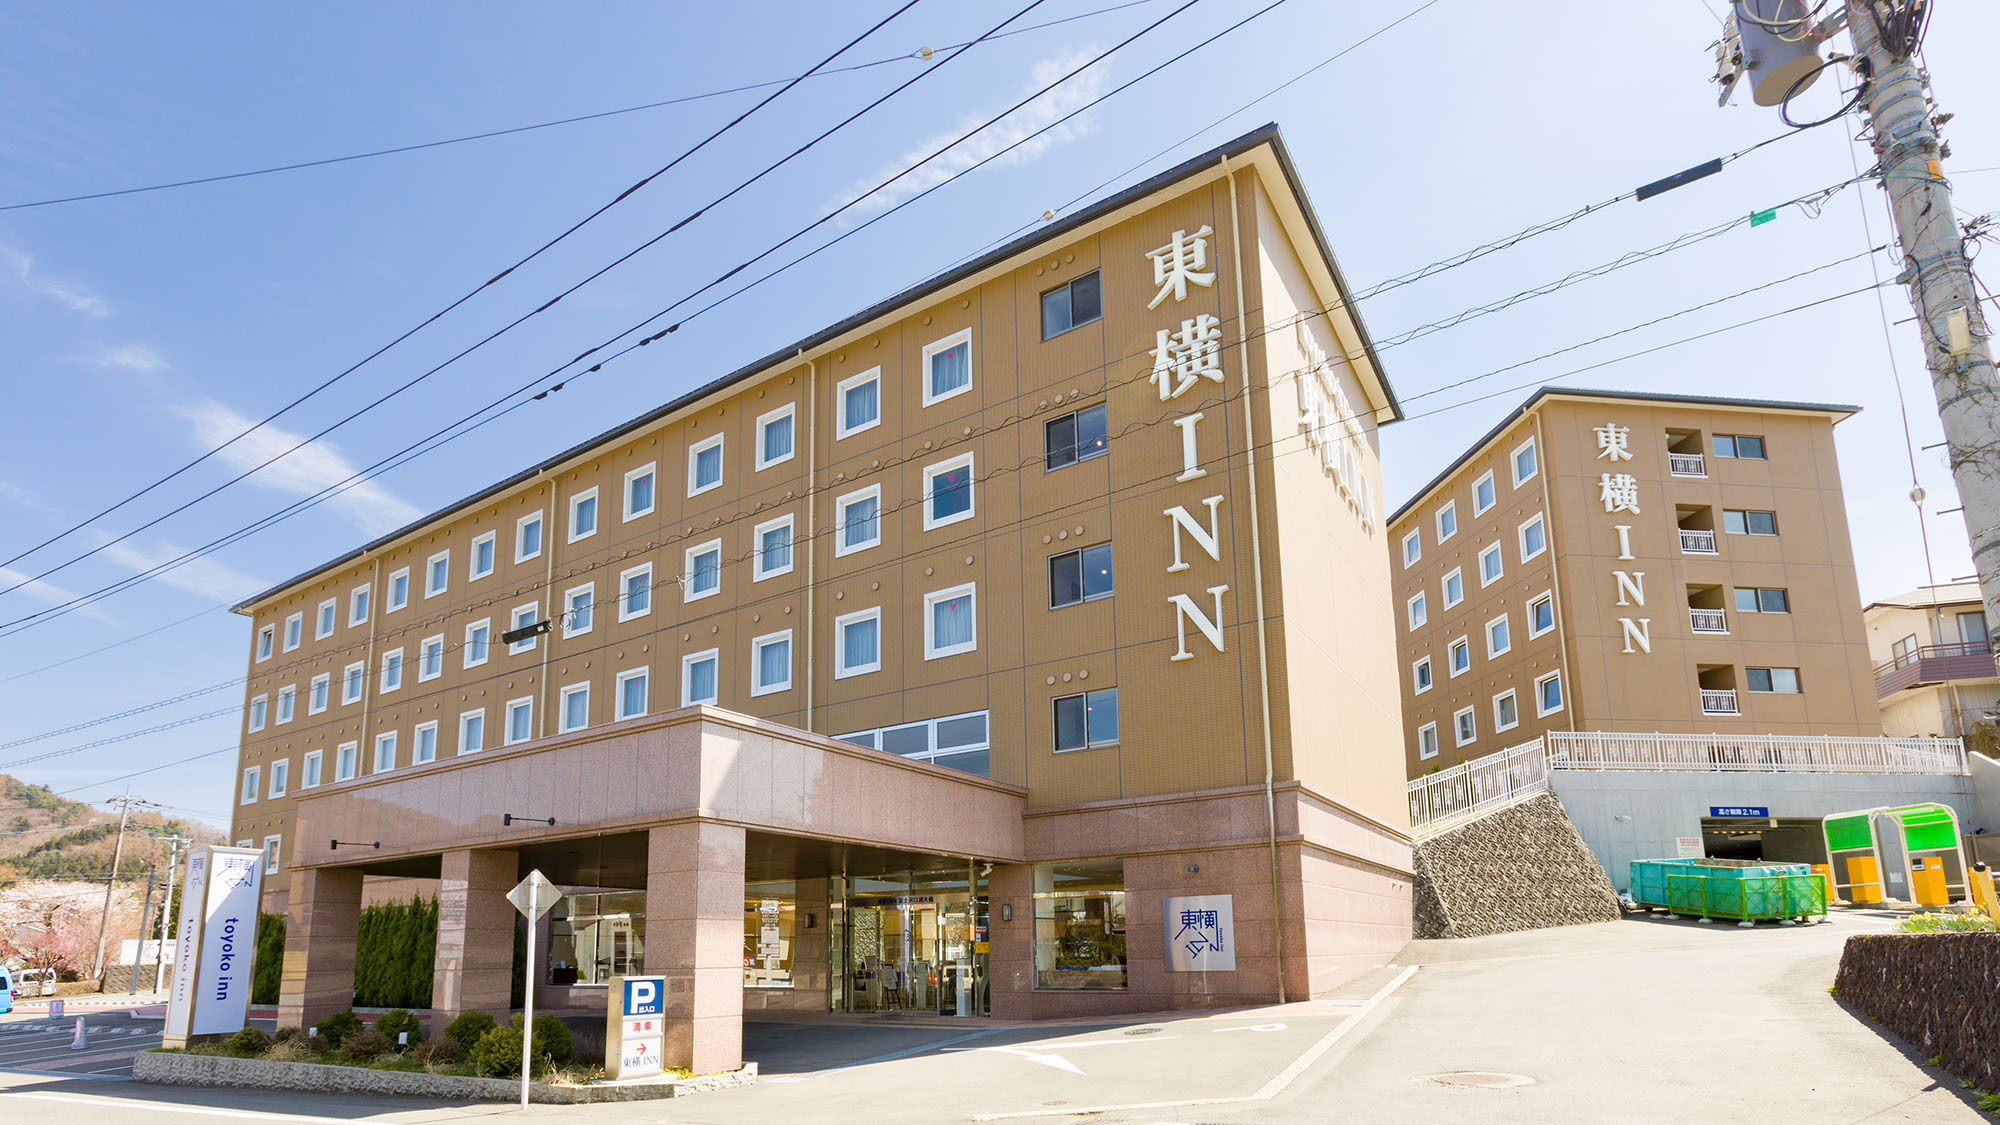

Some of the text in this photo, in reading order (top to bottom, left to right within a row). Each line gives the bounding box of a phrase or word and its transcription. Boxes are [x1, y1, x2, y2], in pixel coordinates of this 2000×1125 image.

[182, 918, 194, 972] toyoko
[216, 917, 239, 1001] toyoko inn
[630, 981, 656, 1014] P
